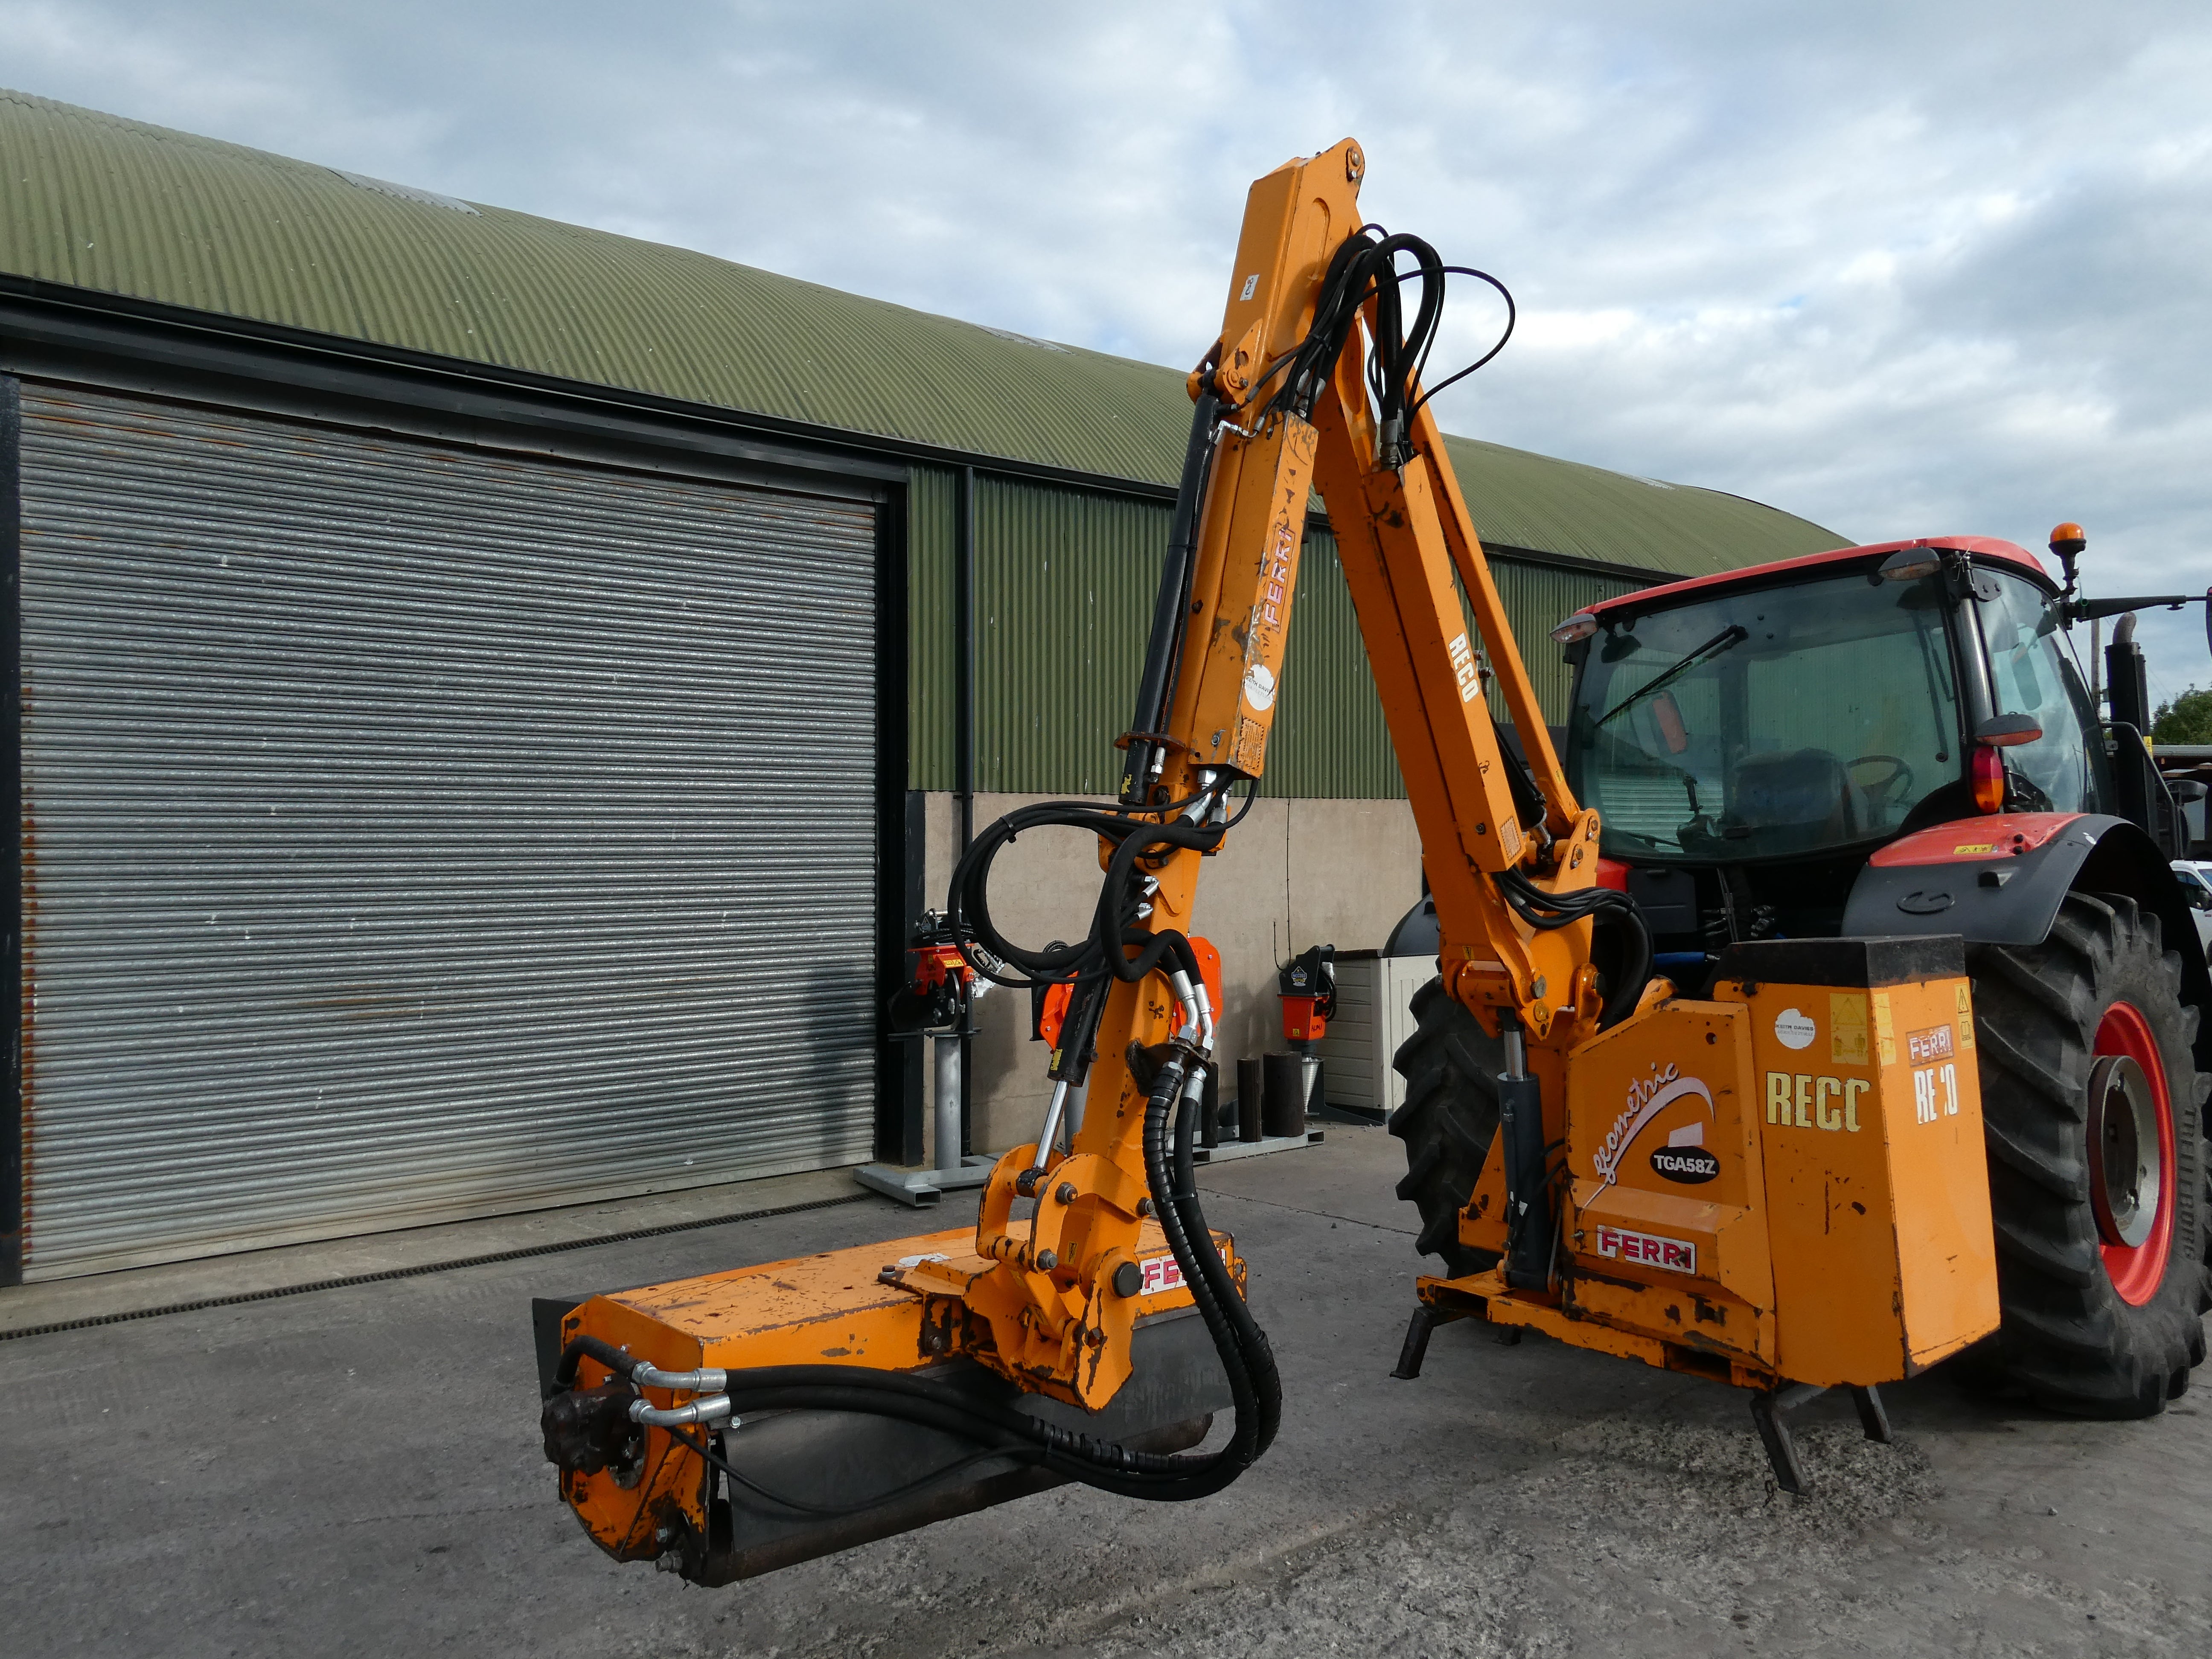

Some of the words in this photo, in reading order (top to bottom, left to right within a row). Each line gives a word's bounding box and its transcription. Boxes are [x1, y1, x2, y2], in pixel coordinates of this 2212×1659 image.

[1264, 529, 1292, 625] FERRI
[1449, 632, 1479, 703] RECO
[1909, 1031, 1950, 1059] FERRI
[1653, 1155, 1716, 1174] TGA58Z
[1602, 1230, 1691, 1269] FERRI
